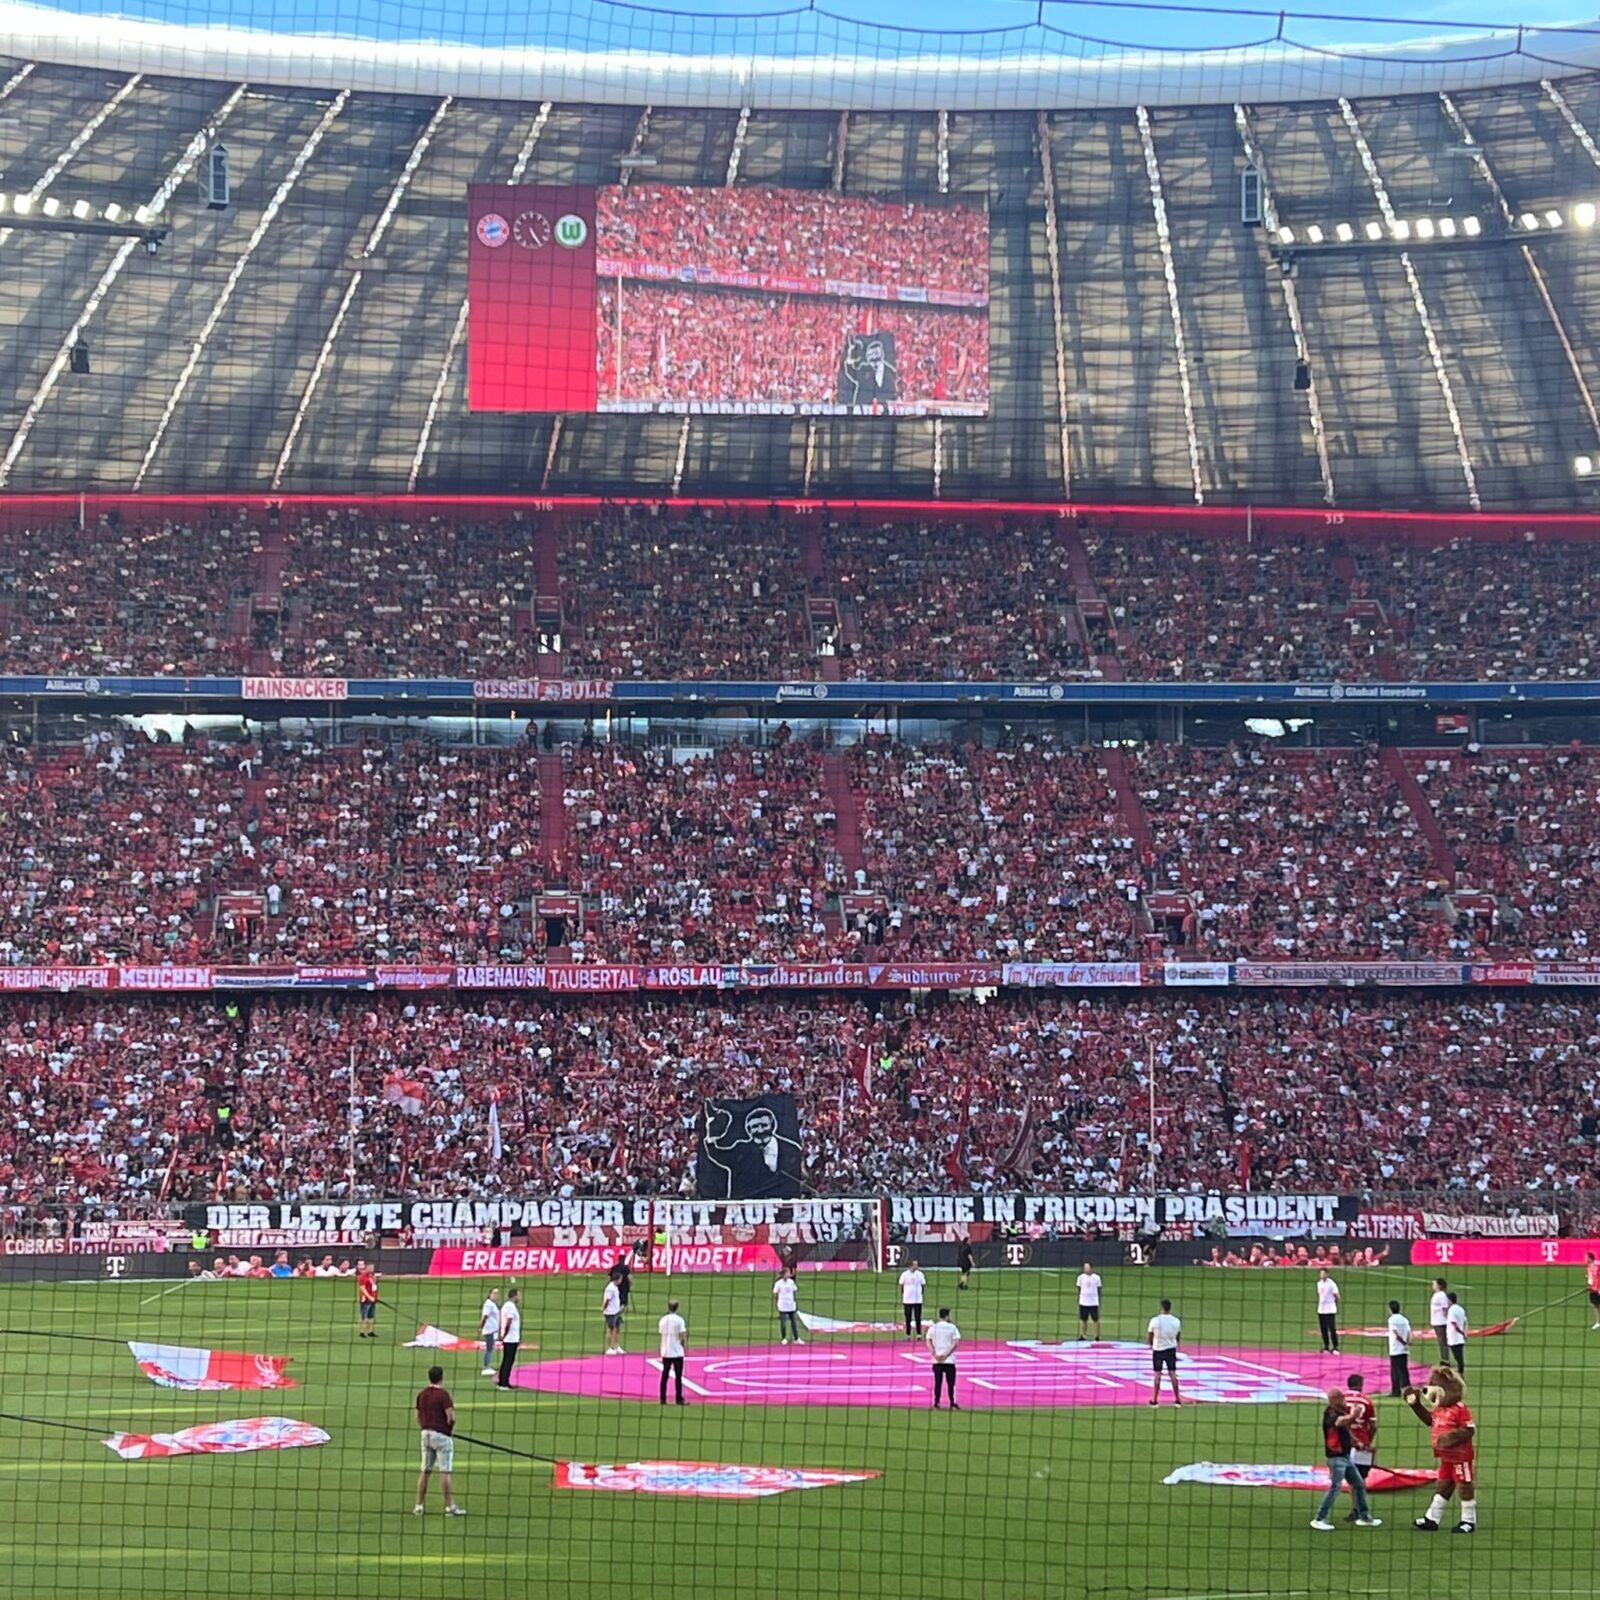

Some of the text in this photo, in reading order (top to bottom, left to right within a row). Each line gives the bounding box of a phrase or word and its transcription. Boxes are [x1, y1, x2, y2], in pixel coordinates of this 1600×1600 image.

[534, 500, 553, 511] 316
[46, 680, 82, 691] Allianz
[245, 680, 346, 698] HAINSACKER
[473, 681, 614, 699] GIESSEN BULLS
[778, 685, 812, 696] Allianz
[1013, 686, 1048, 697] Allianz
[1294, 686, 1426, 697] Allianz Global Investors
[549, 969, 639, 989] TAUBERTAL
[206, 1189, 1340, 1230] DER LETZTE CHAMPAGNER GEHT AUF DICH RUHE IN FRIEDEN PRÄSIDENT
[1428, 1216, 1557, 1234] ANZENKIRCHEN
[5, 1239, 65, 1255] COBRAS
[1007, 1243, 1024, 1265] T
[1436, 1242, 1454, 1263] T
[1541, 1241, 1559, 1263] T
[106, 1256, 125, 1278] T
[461, 1250, 561, 1273] ERLEBEN,
[566, 1248, 615, 1270] WAS
